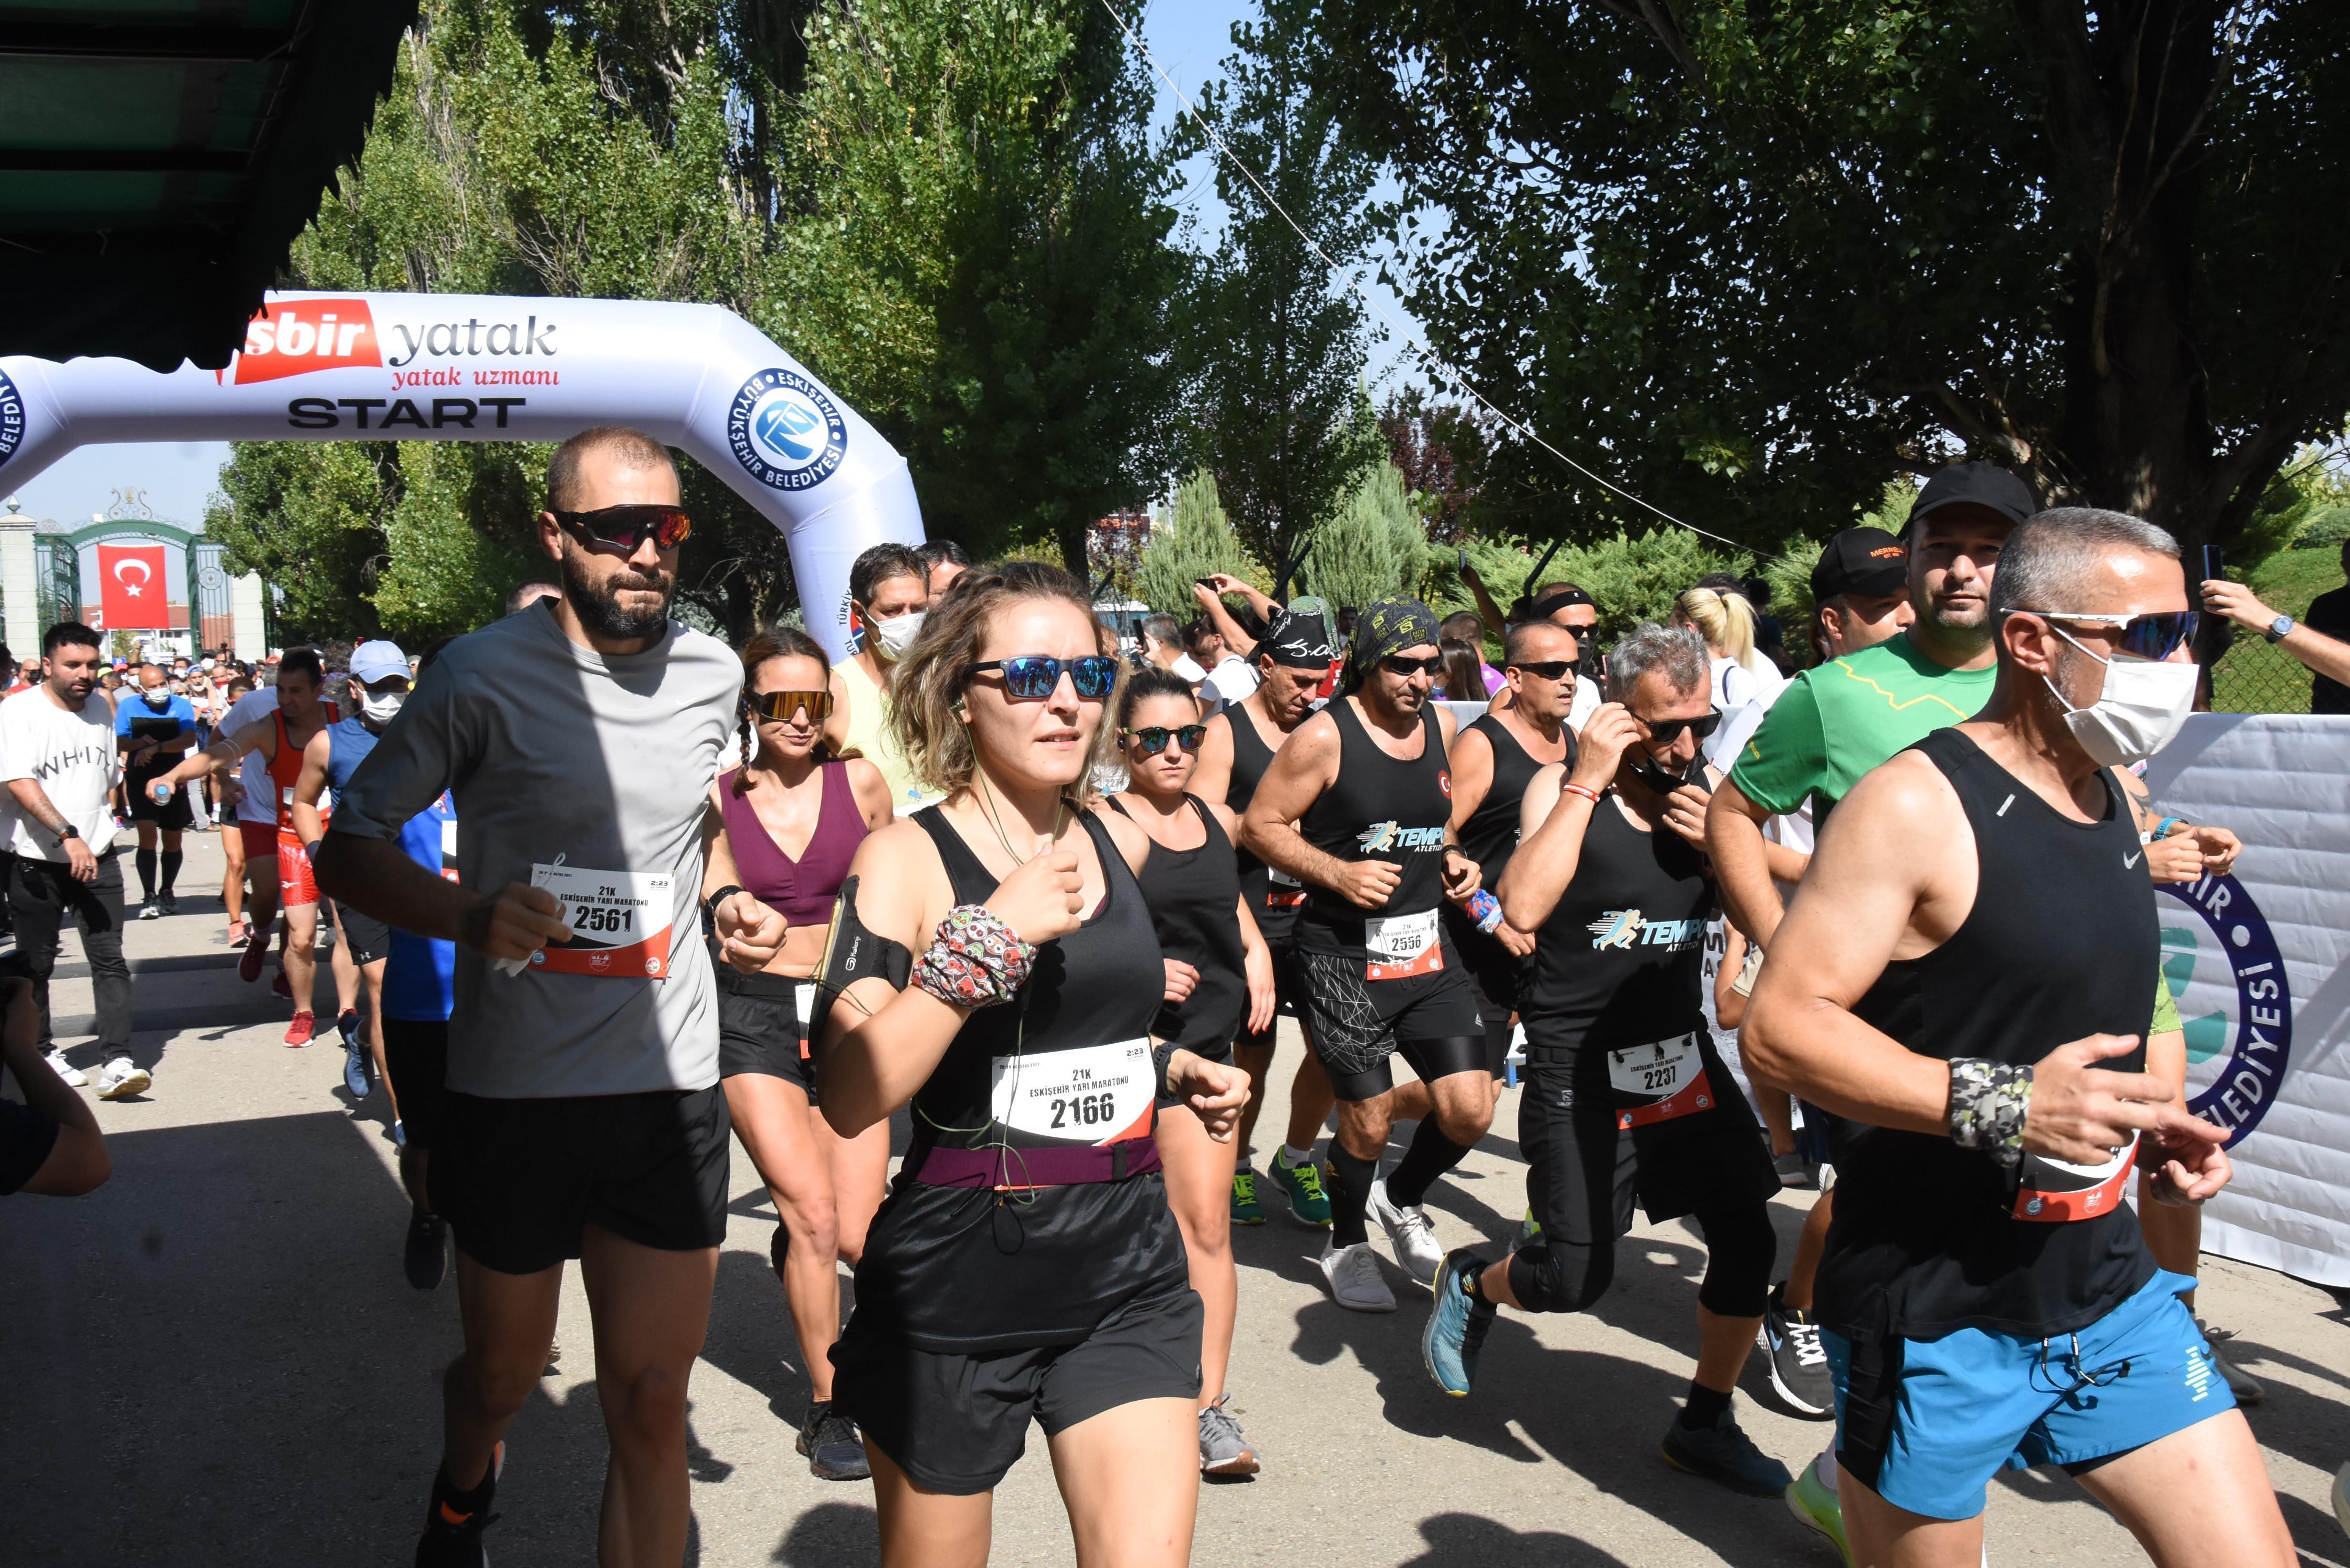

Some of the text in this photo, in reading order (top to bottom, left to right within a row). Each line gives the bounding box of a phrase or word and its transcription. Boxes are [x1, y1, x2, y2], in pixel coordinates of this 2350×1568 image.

[388, 315, 557, 367] yatak
[391, 366, 560, 391] yatak uzmanı
[777, 372, 841, 427] ESKİŞEHİR
[287, 398, 526, 429] START
[729, 377, 843, 487] BÜYÜKŞEHİR BELEDİYESİ
[836, 586, 852, 626] TÜRKİY
[32, 745, 111, 780] WHIT
[560, 893, 595, 903] ESKİŞEHİR
[614, 898, 648, 906] MARATONU
[599, 886, 617, 896] 21K
[573, 905, 632, 932] 2561
[1641, 918, 1708, 945] TEMPO
[1391, 935, 1421, 952] 2556
[1126, 1047, 1144, 1057] 2:23
[2195, 961, 2281, 1133] LEDİYESİ
[1030, 1075, 1129, 1098] ESKİŞEHİR YARI MARATONU
[1073, 1068, 1091, 1081] 21K
[1644, 1065, 1676, 1090] 2237
[1051, 1092, 1114, 1129] 2166
